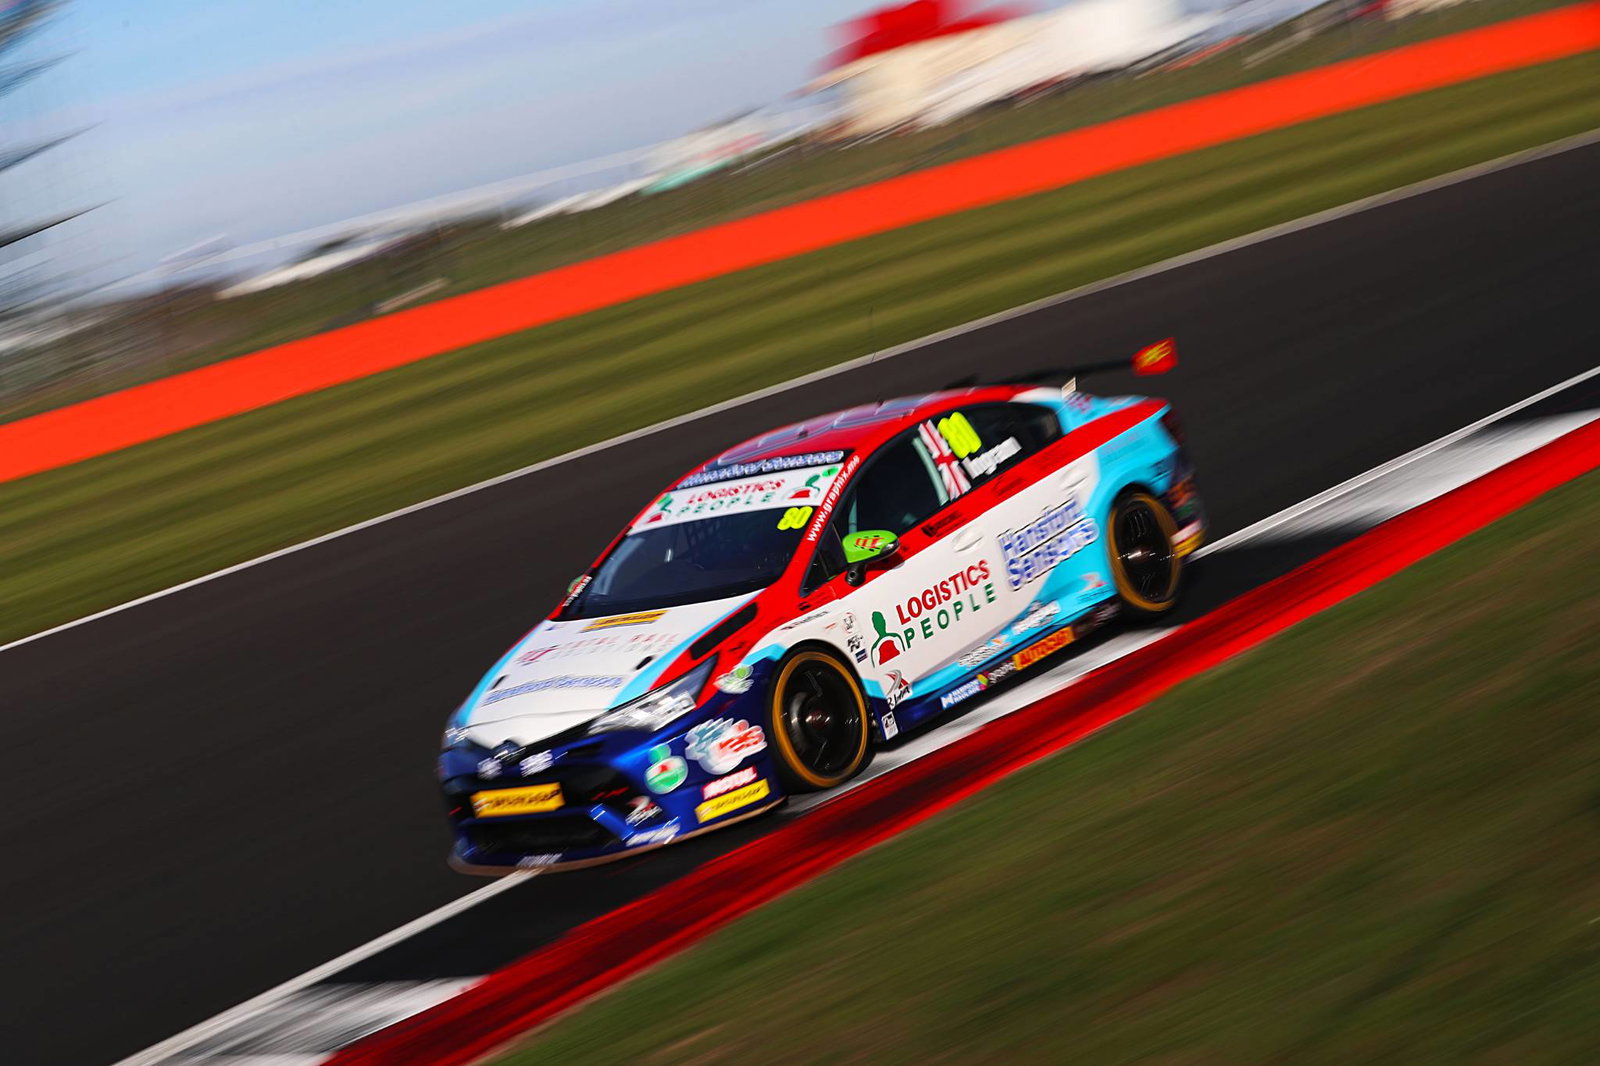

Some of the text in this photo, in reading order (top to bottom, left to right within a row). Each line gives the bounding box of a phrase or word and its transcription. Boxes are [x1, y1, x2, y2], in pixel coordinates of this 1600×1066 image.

[806, 455, 861, 543] www.graphix.me
[895, 559, 990, 625] LOGISTICS
[903, 582, 997, 649] PEOPLE
